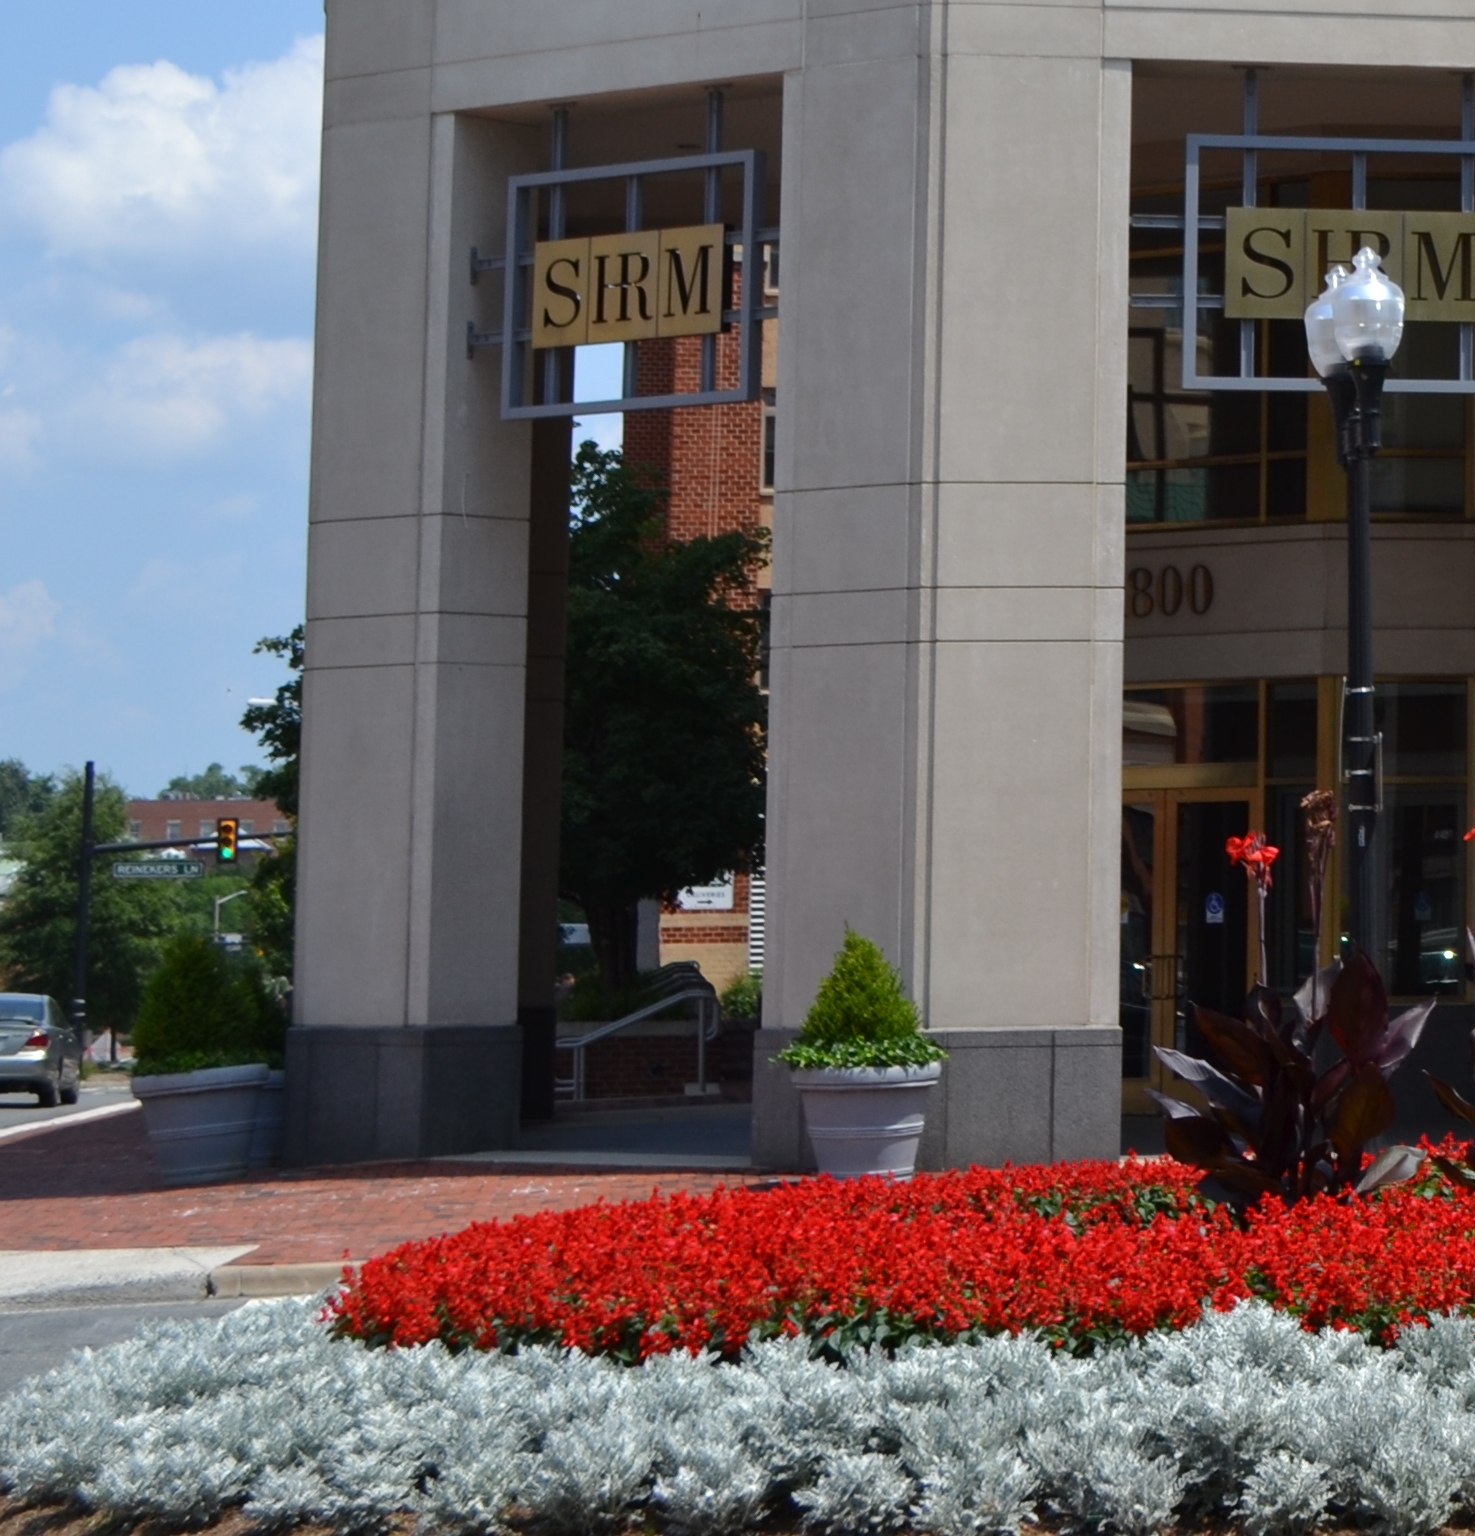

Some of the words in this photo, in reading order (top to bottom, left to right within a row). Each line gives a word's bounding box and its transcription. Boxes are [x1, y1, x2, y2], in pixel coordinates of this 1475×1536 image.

[543, 244, 715, 329] SHRM
[1124, 564, 1214, 619] 800
[183, 865, 199, 875] LN
[687, 891, 726, 899] ELIVERIES
